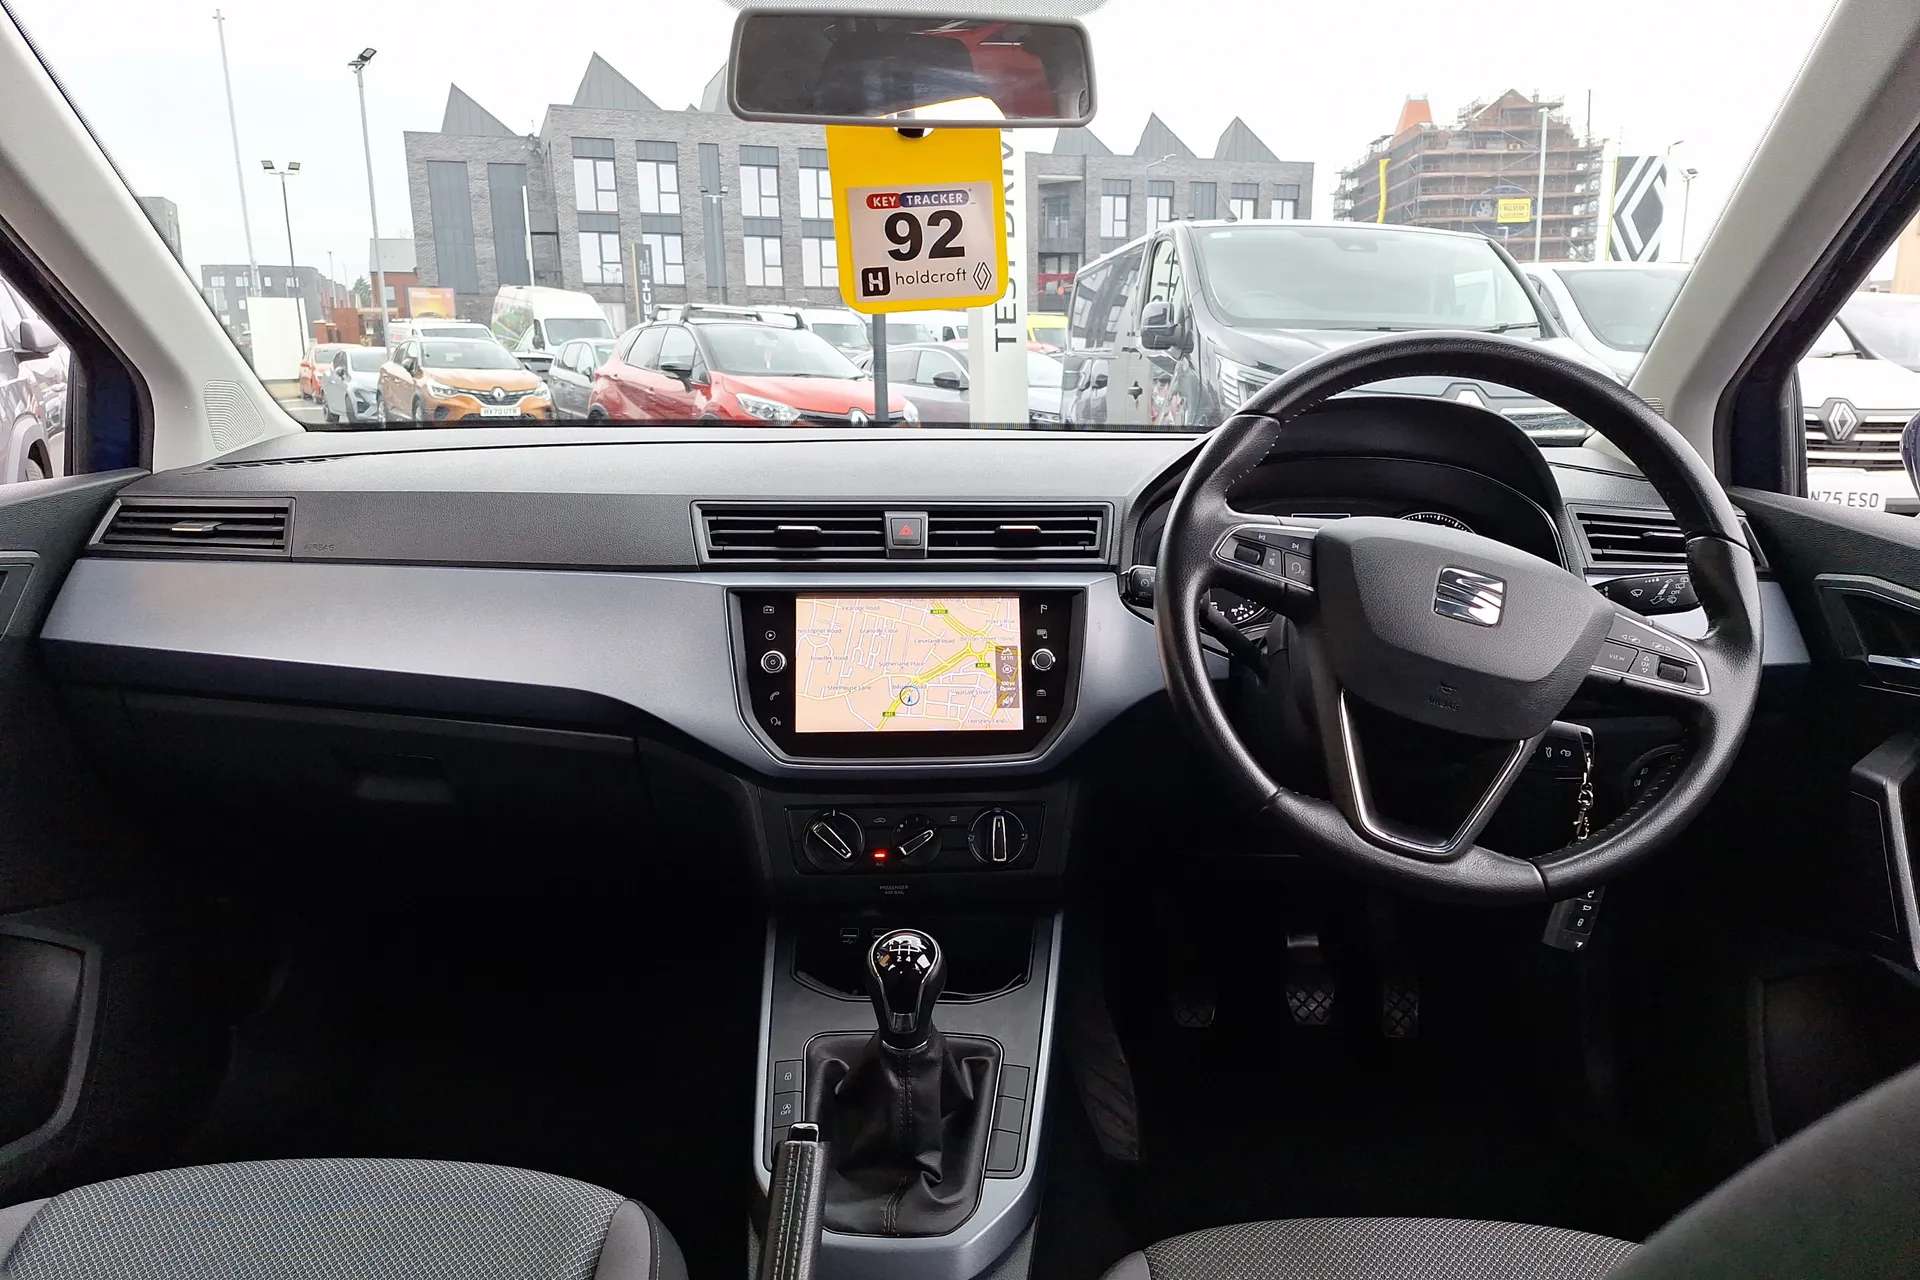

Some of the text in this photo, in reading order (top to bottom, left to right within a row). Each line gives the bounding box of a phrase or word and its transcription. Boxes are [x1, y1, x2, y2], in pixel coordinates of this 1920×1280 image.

[872, 193, 963, 207] KEY TRACKER
[884, 209, 966, 262] 92
[895, 267, 967, 286] holdcroft
